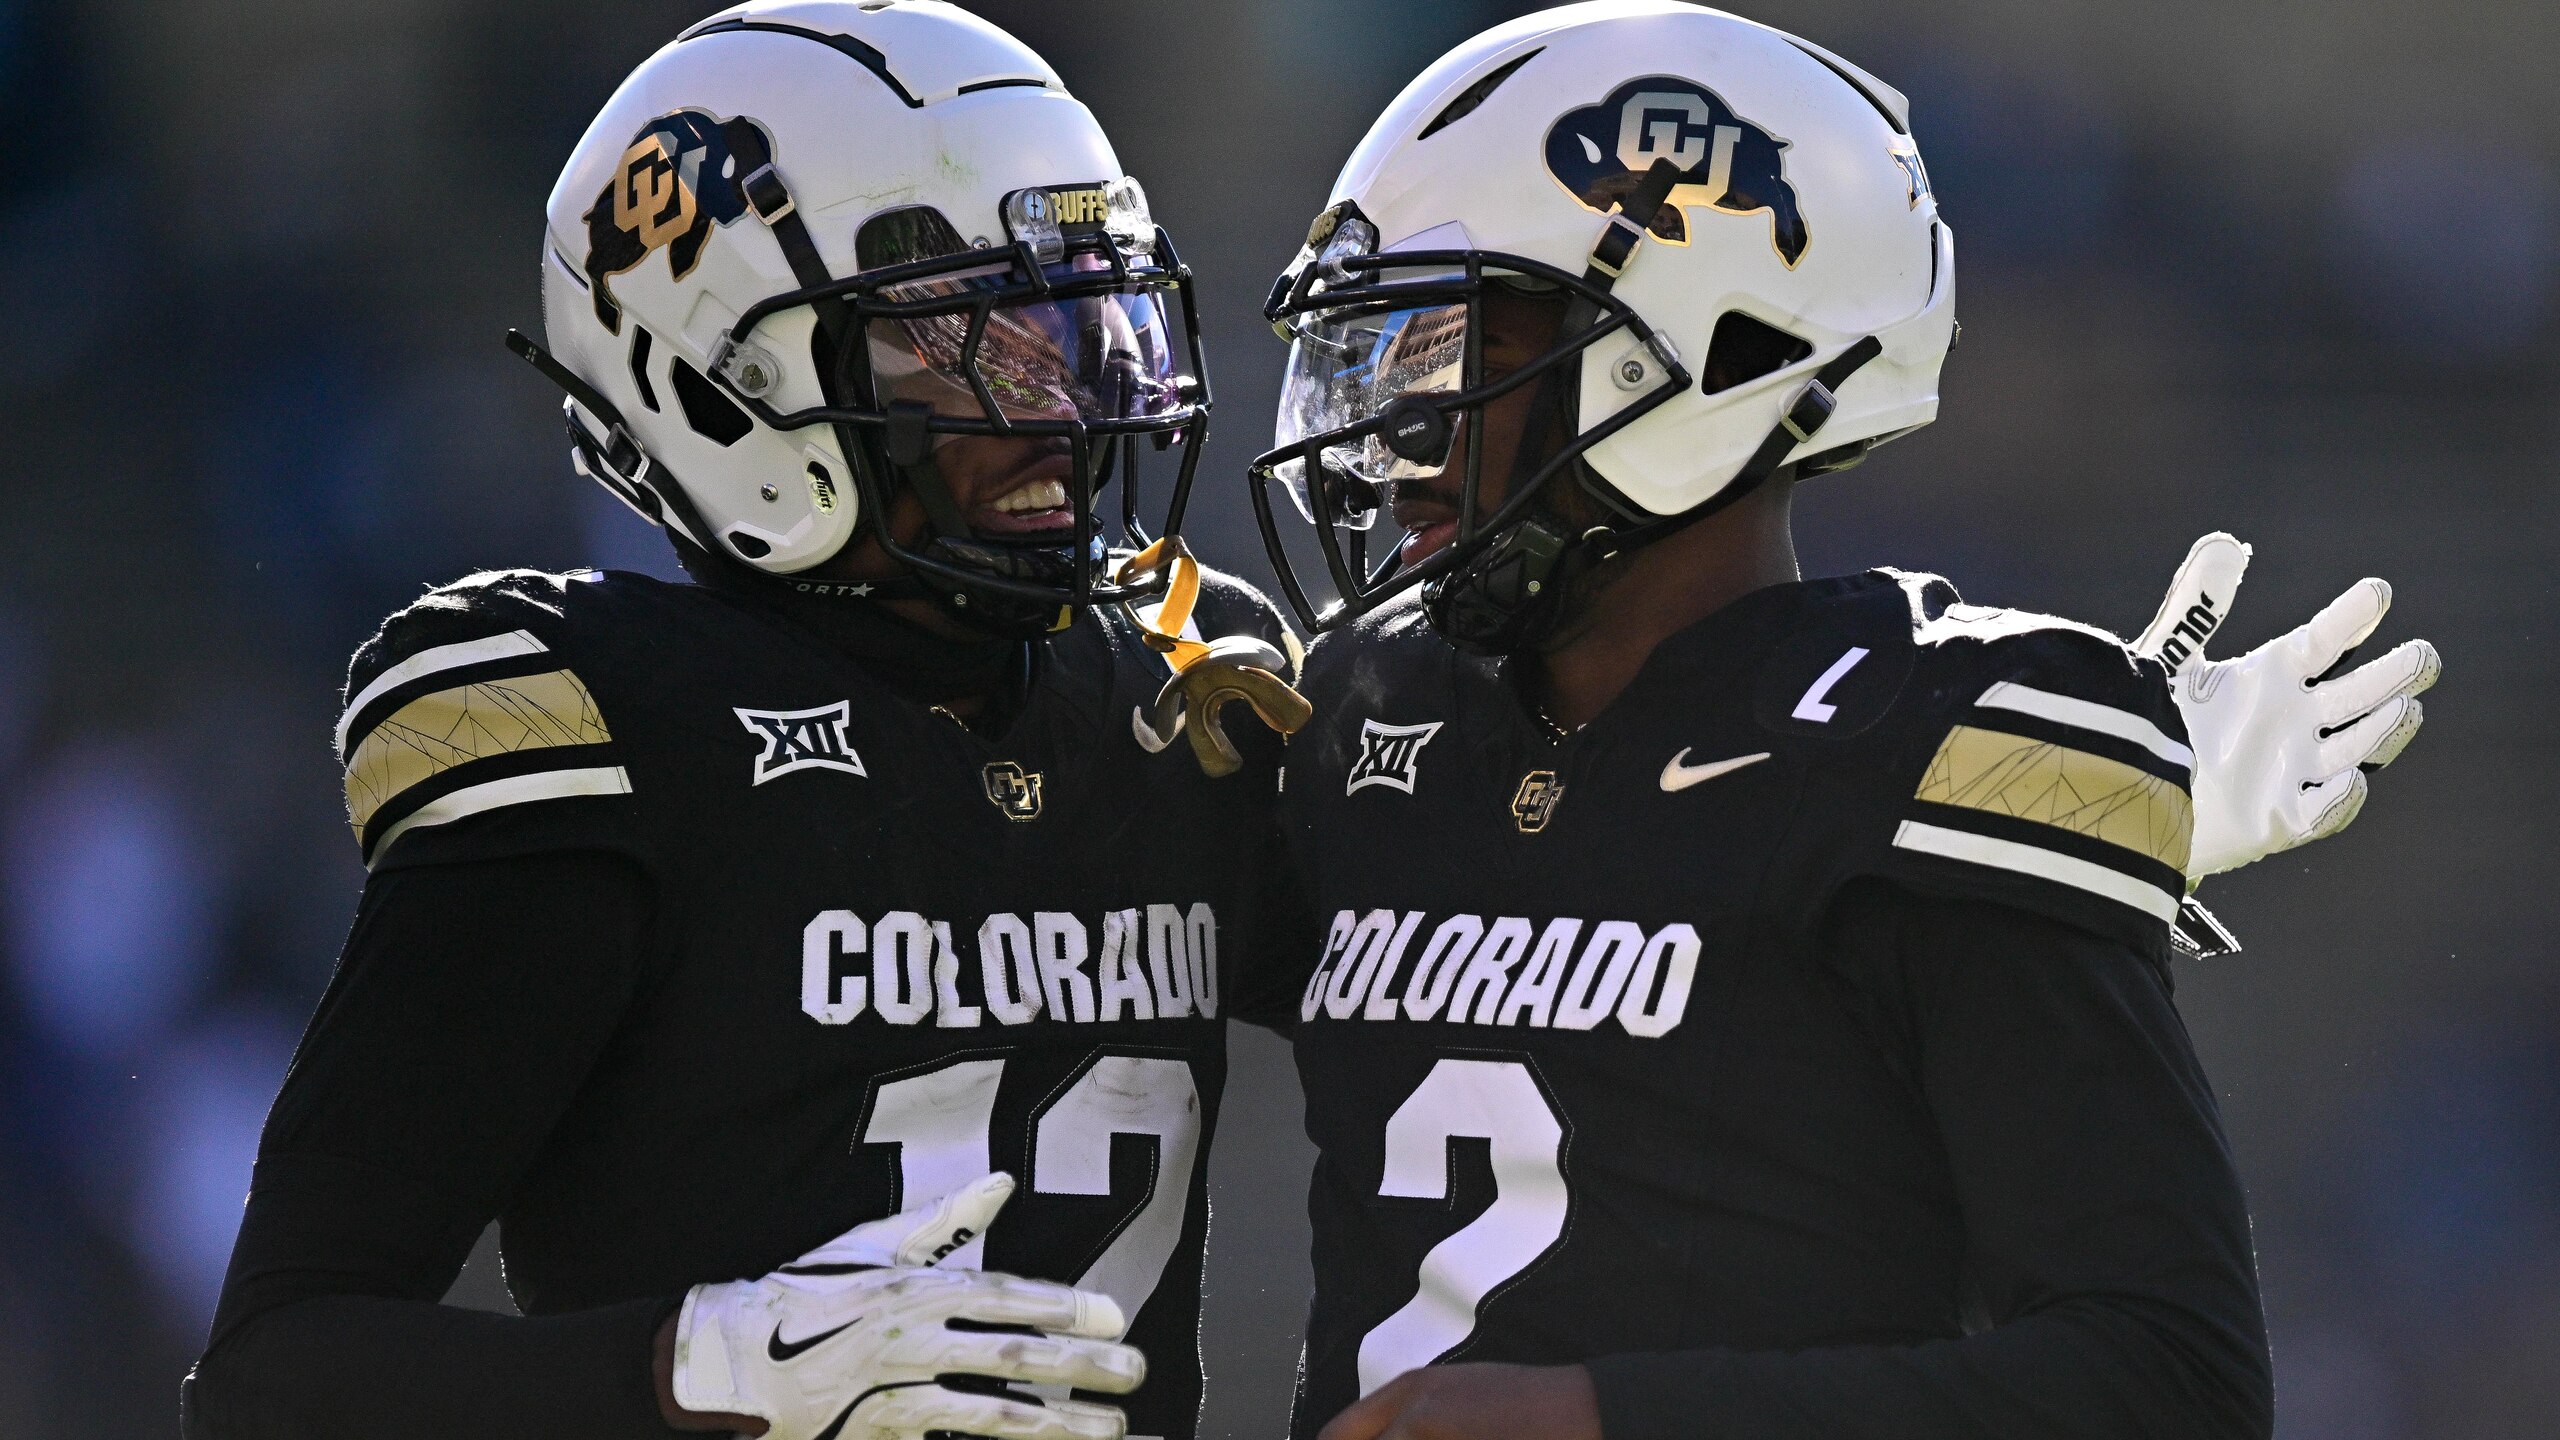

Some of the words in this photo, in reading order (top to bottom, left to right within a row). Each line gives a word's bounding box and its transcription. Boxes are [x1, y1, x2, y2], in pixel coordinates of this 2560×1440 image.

[613, 131, 707, 251] CU
[1044, 190, 1109, 225] BUFFS
[746, 707, 859, 775] XII
[1349, 727, 1433, 786] XII
[982, 761, 1042, 820] CU
[1510, 770, 1565, 833] CU
[801, 902, 1219, 1028] COLORADO
[1300, 908, 1702, 1038] COLORADO
[863, 1055, 1201, 1440] 12
[1357, 1058, 1568, 1401] 2
